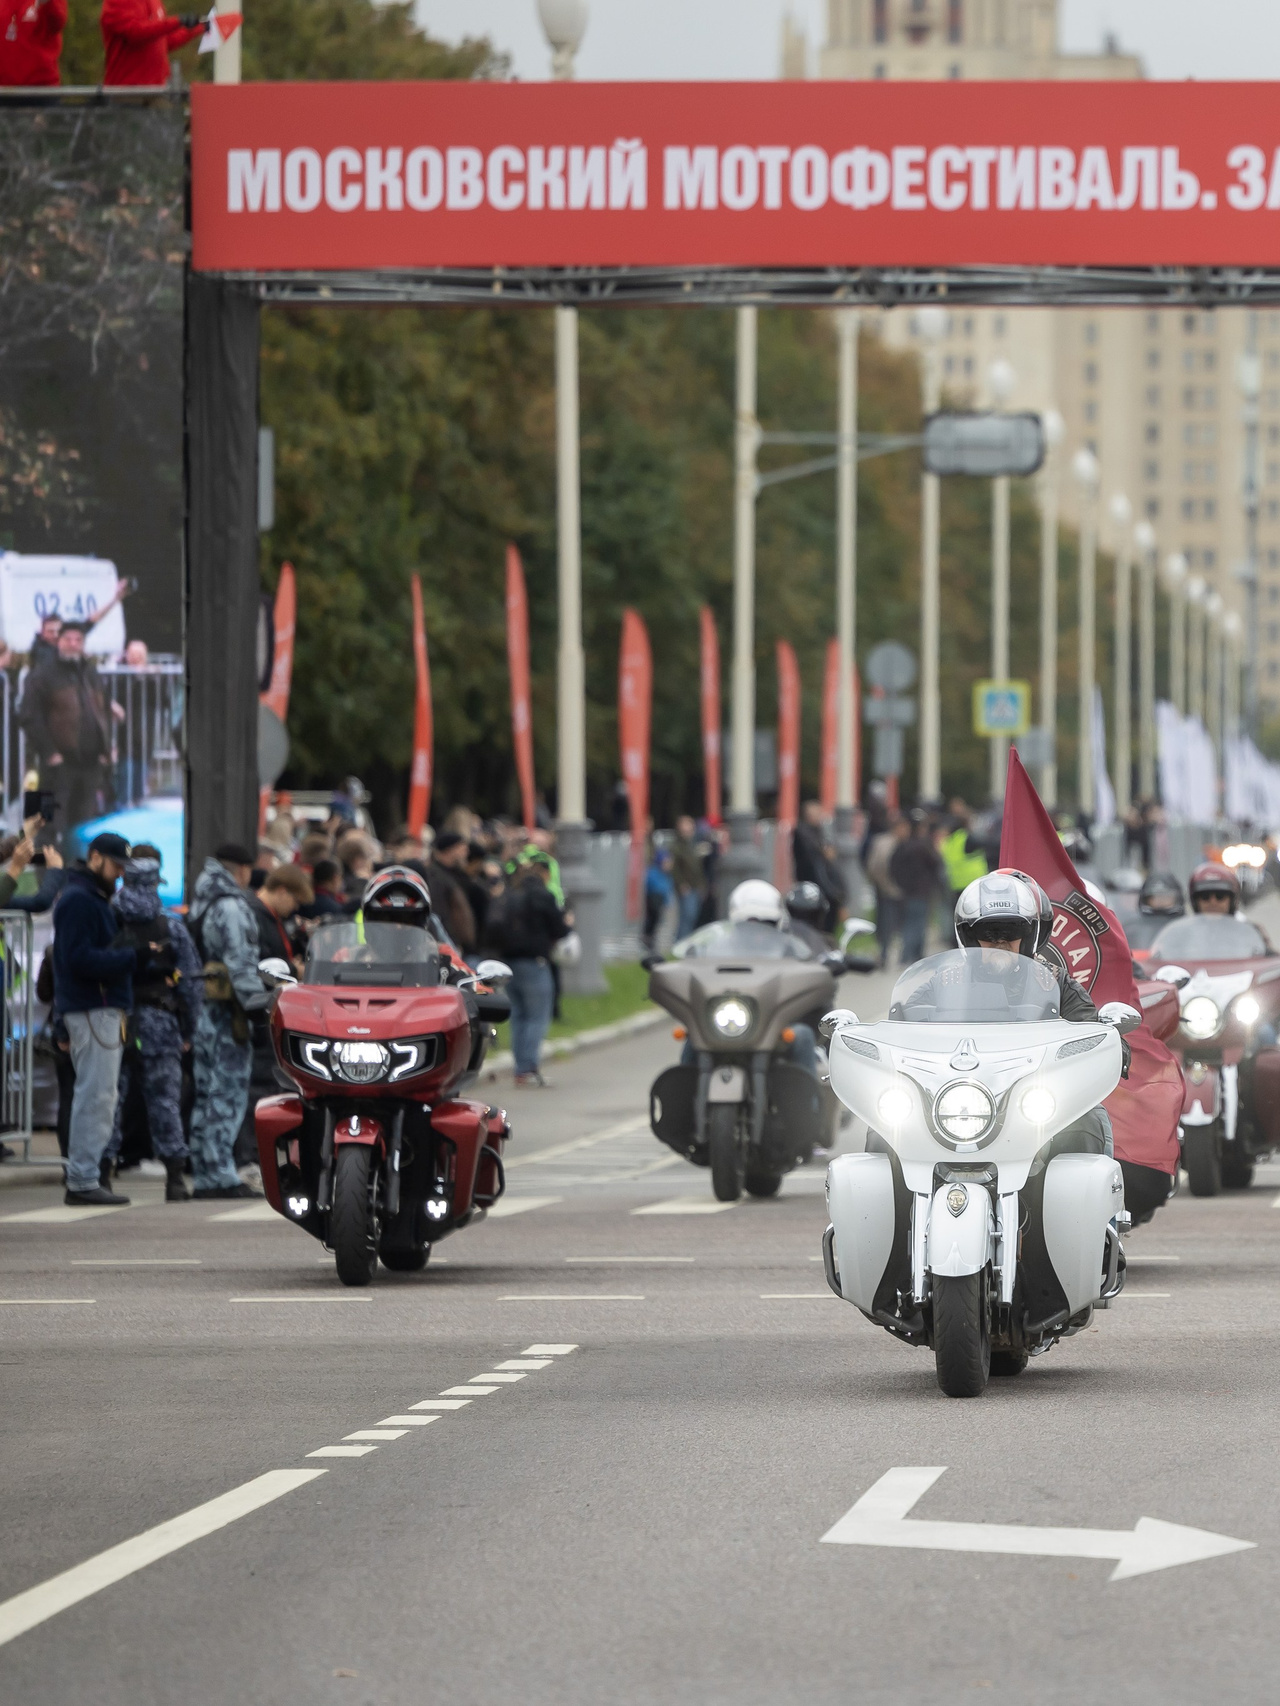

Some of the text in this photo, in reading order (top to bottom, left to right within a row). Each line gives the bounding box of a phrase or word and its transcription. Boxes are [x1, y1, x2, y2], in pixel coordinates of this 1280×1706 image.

[226, 138, 648, 212] МОСКОВСКИЙ
[663, 145, 1218, 211] МОТОФЕСТИВАЛЬ.
[1051, 913, 1092, 984] DIAN
[1079, 904, 1100, 923] 1901
